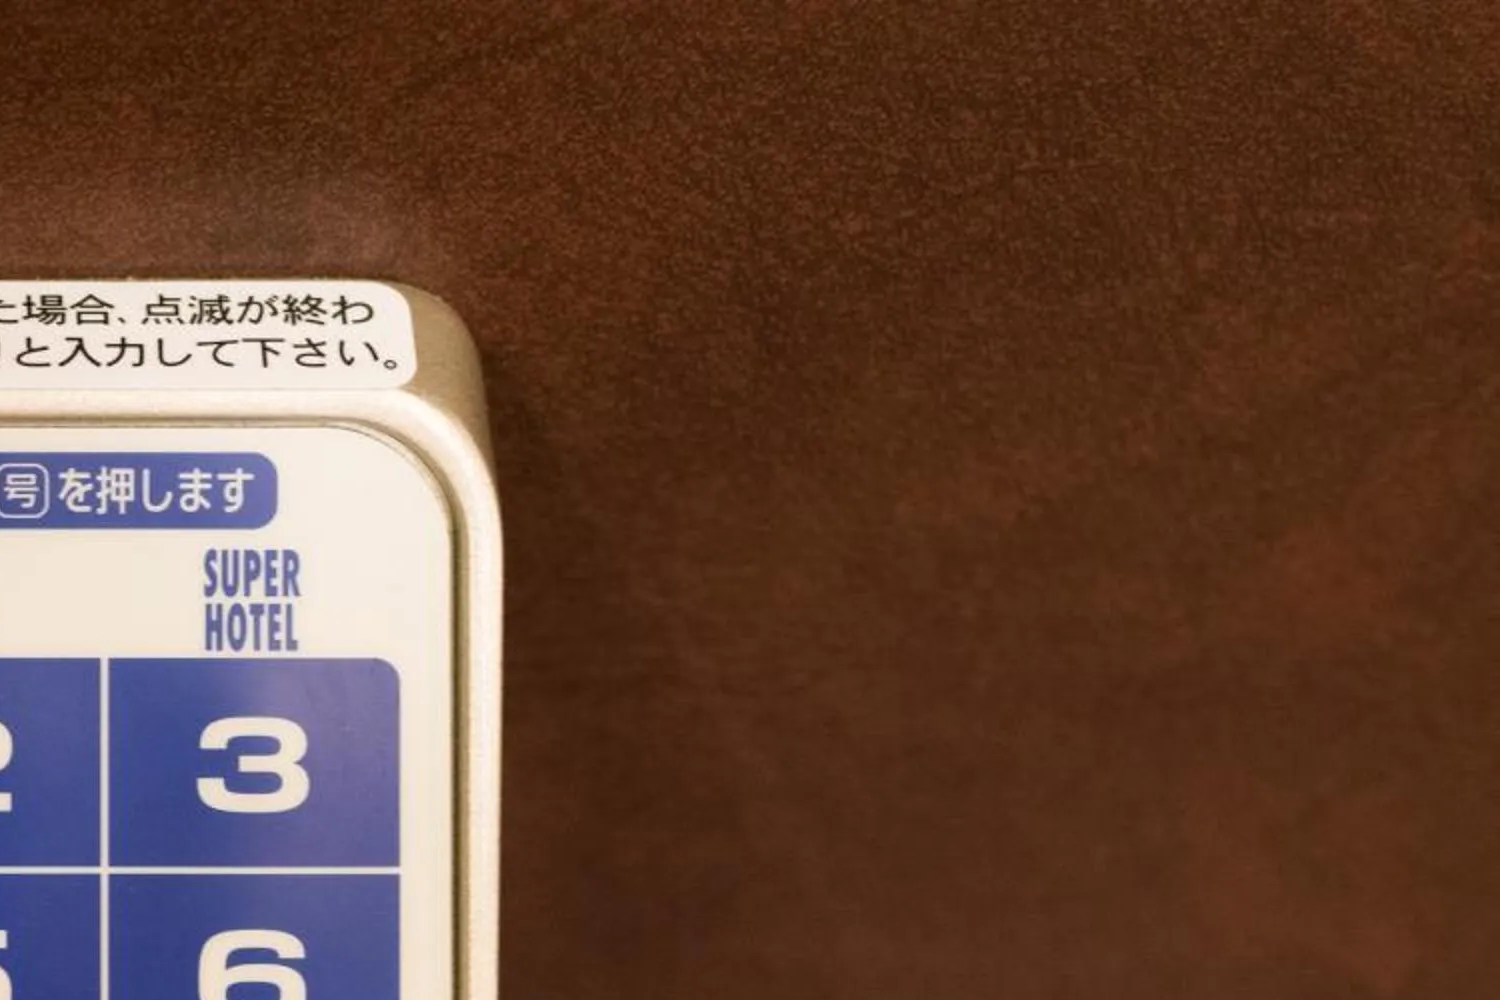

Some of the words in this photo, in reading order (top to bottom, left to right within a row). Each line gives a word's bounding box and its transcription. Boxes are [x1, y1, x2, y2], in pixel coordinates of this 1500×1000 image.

[203, 548, 301, 598] SUPER
[204, 602, 299, 652] HOTEL
[197, 716, 309, 812] 3
